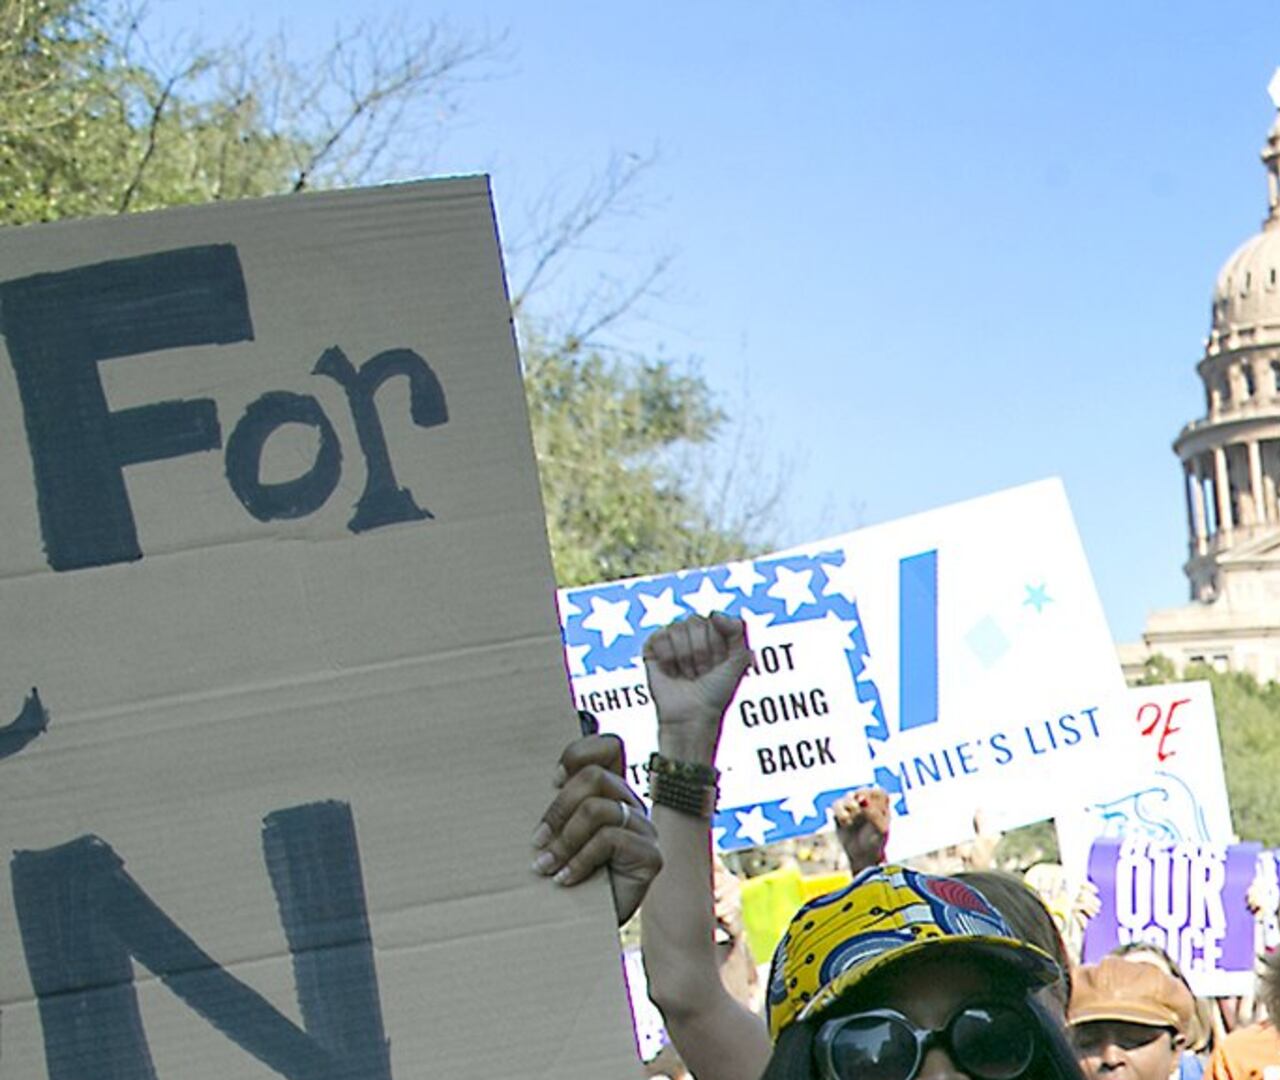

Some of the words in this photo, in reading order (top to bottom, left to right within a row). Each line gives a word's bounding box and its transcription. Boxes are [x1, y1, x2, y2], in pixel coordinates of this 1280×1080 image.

[0, 243, 449, 573] For
[580, 684, 648, 713] IGHTS
[740, 688, 829, 728] GOING
[1024, 706, 1100, 755] LIST
[758, 737, 836, 775] BACK
[1116, 856, 1227, 930] OUR
